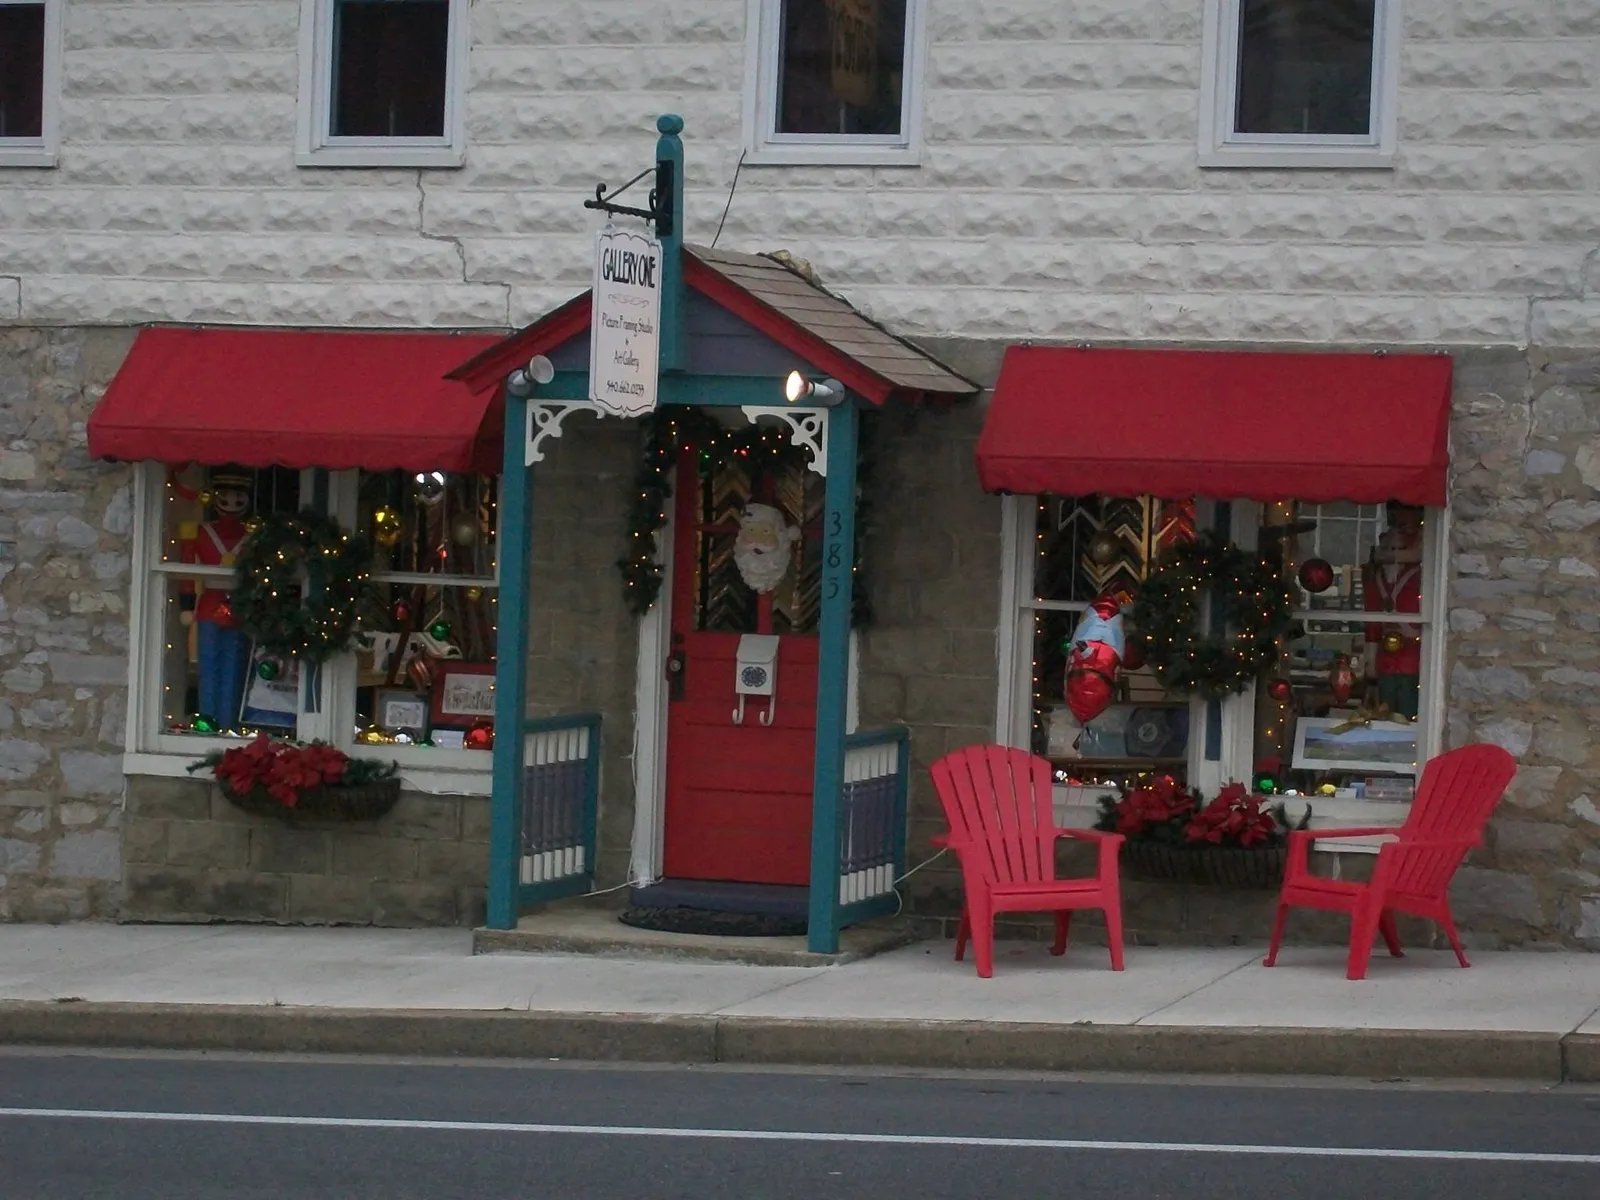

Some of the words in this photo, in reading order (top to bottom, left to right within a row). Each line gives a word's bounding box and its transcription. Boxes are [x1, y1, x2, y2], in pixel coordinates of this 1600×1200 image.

[603, 248, 638, 285] GALLERY
[638, 254, 656, 288] ONE
[827, 511, 842, 600] 385
